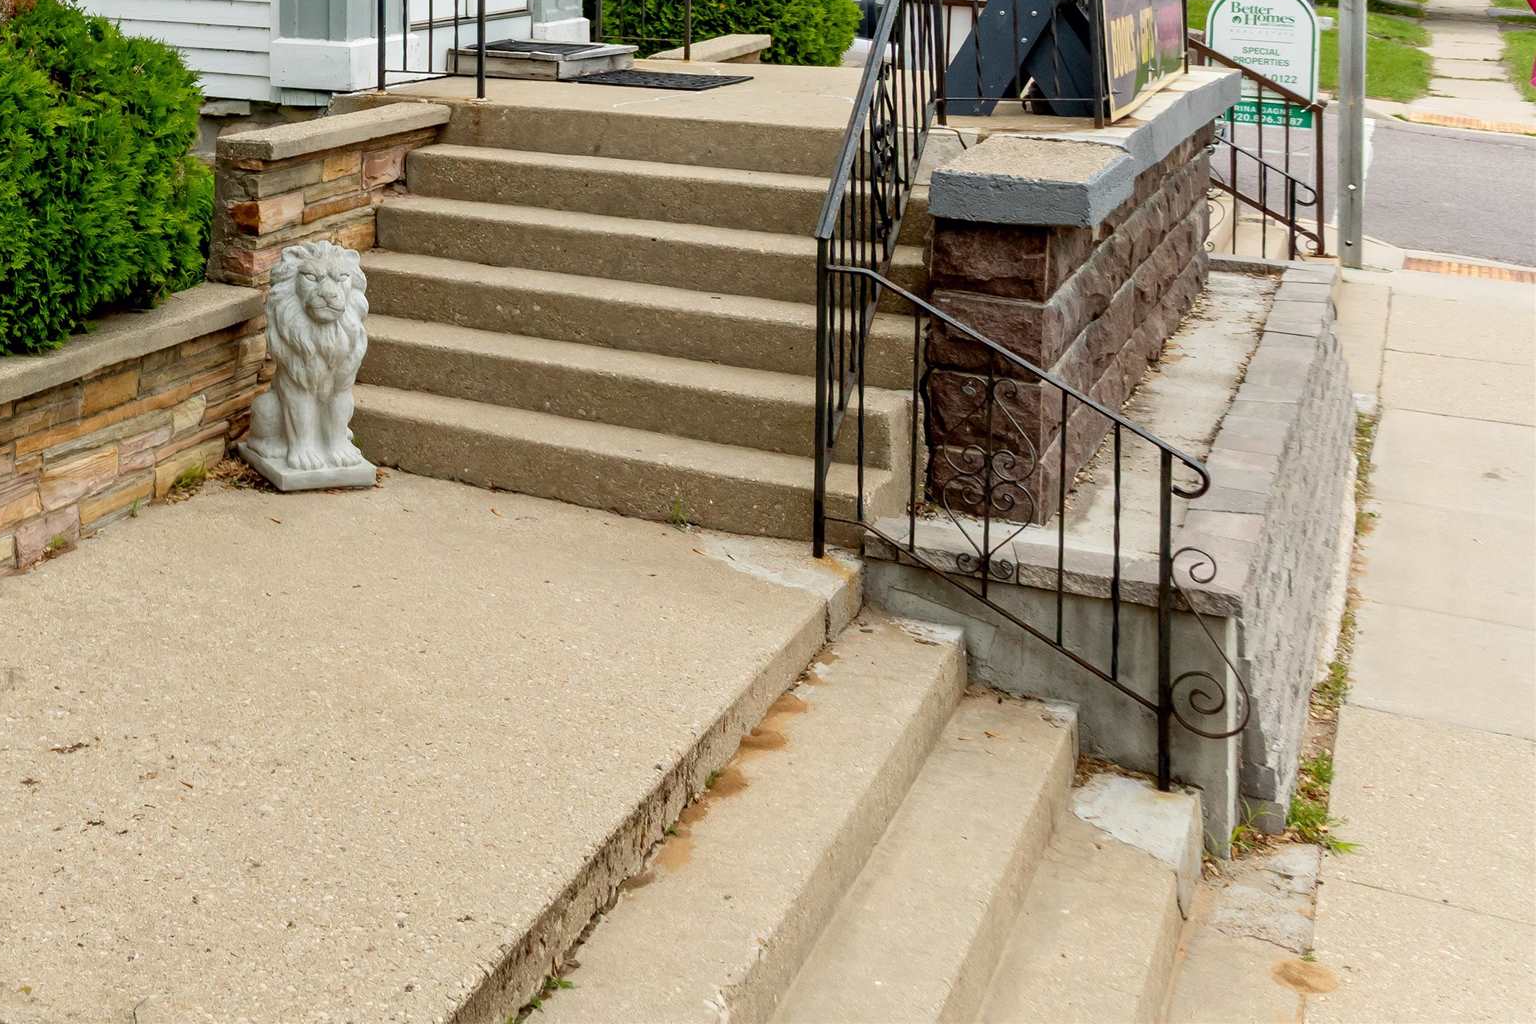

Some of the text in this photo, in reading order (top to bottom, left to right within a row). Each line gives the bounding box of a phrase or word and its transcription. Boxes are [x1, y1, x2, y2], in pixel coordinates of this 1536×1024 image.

[1231, 1, 1274, 14] Better
[1244, 14, 1295, 26] Homes
[1242, 47, 1280, 56] SPECIAL
[1233, 56, 1290, 67] PROPERTIES
